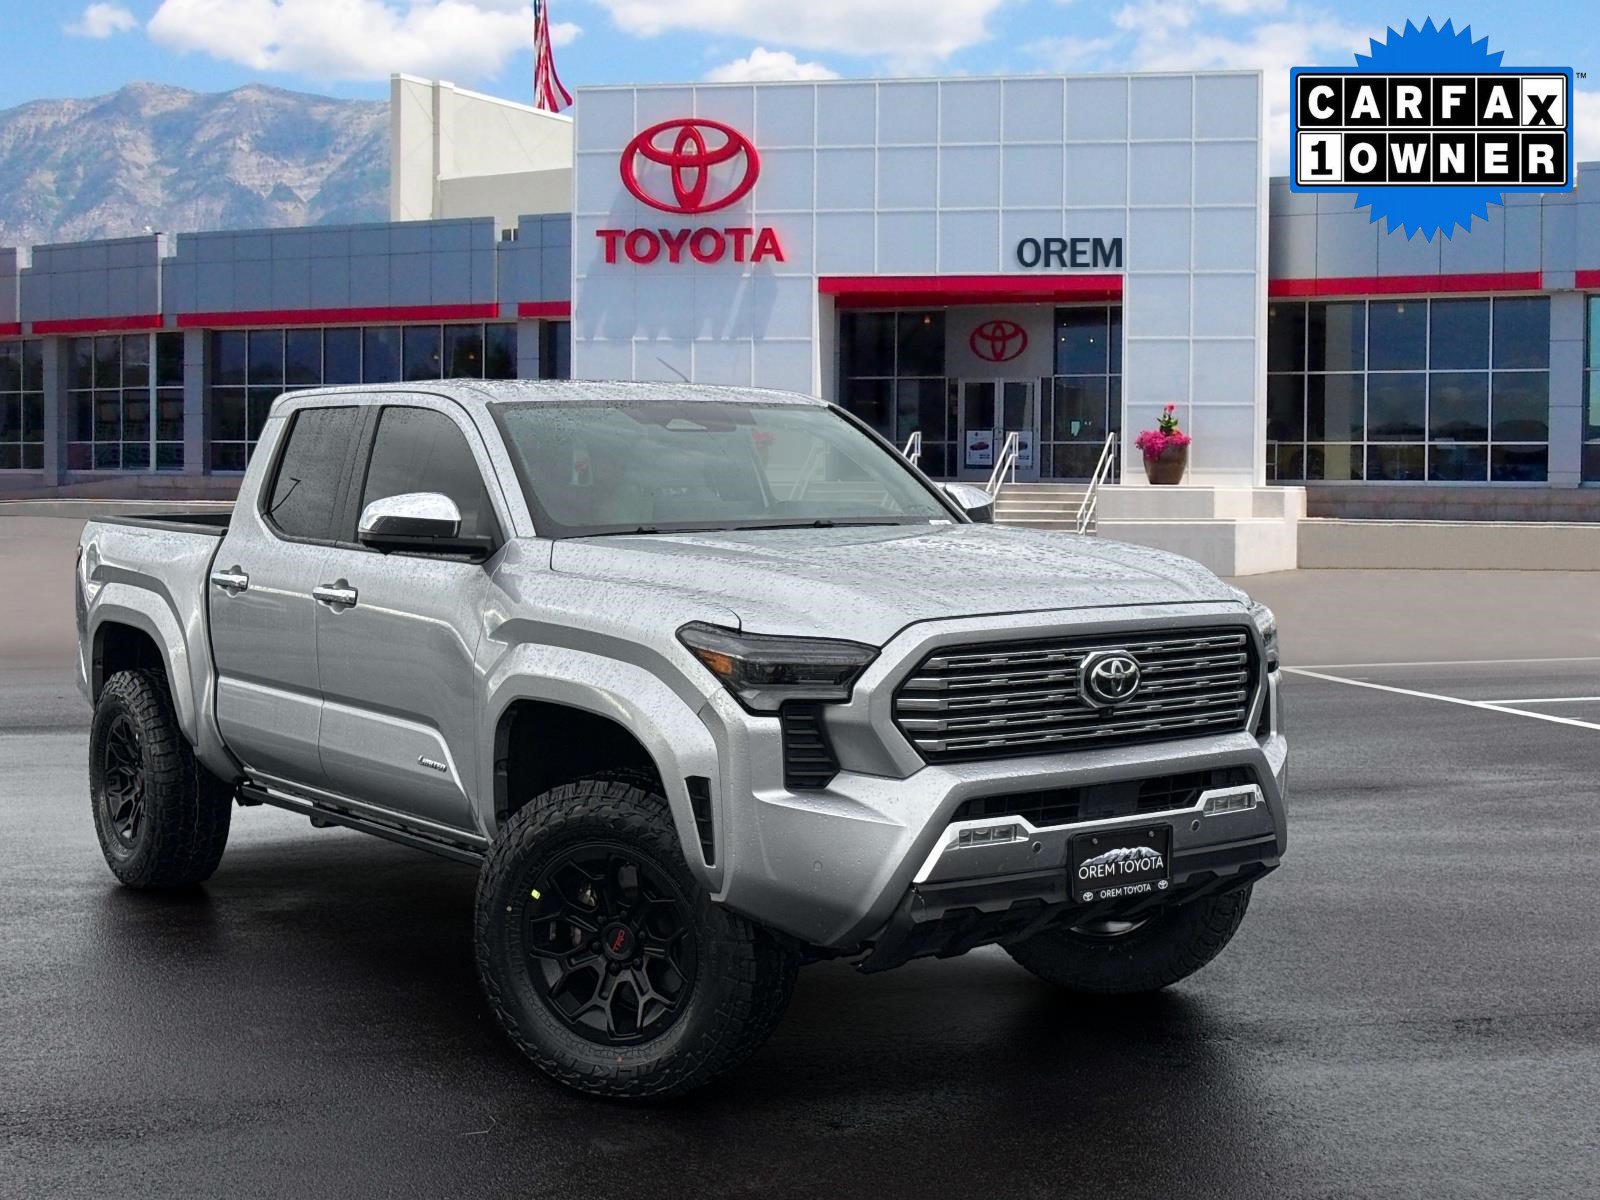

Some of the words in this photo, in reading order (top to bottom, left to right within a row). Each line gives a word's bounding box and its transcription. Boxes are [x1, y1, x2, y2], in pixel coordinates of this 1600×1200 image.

[595, 227, 785, 264] TOYOTA
[1016, 237, 1123, 268] OREM
[1078, 862, 1115, 880] OREM
[1117, 856, 1164, 874] TOYOTA
[1100, 887, 1122, 899] OREM
[1123, 883, 1151, 895] TOYOTA
